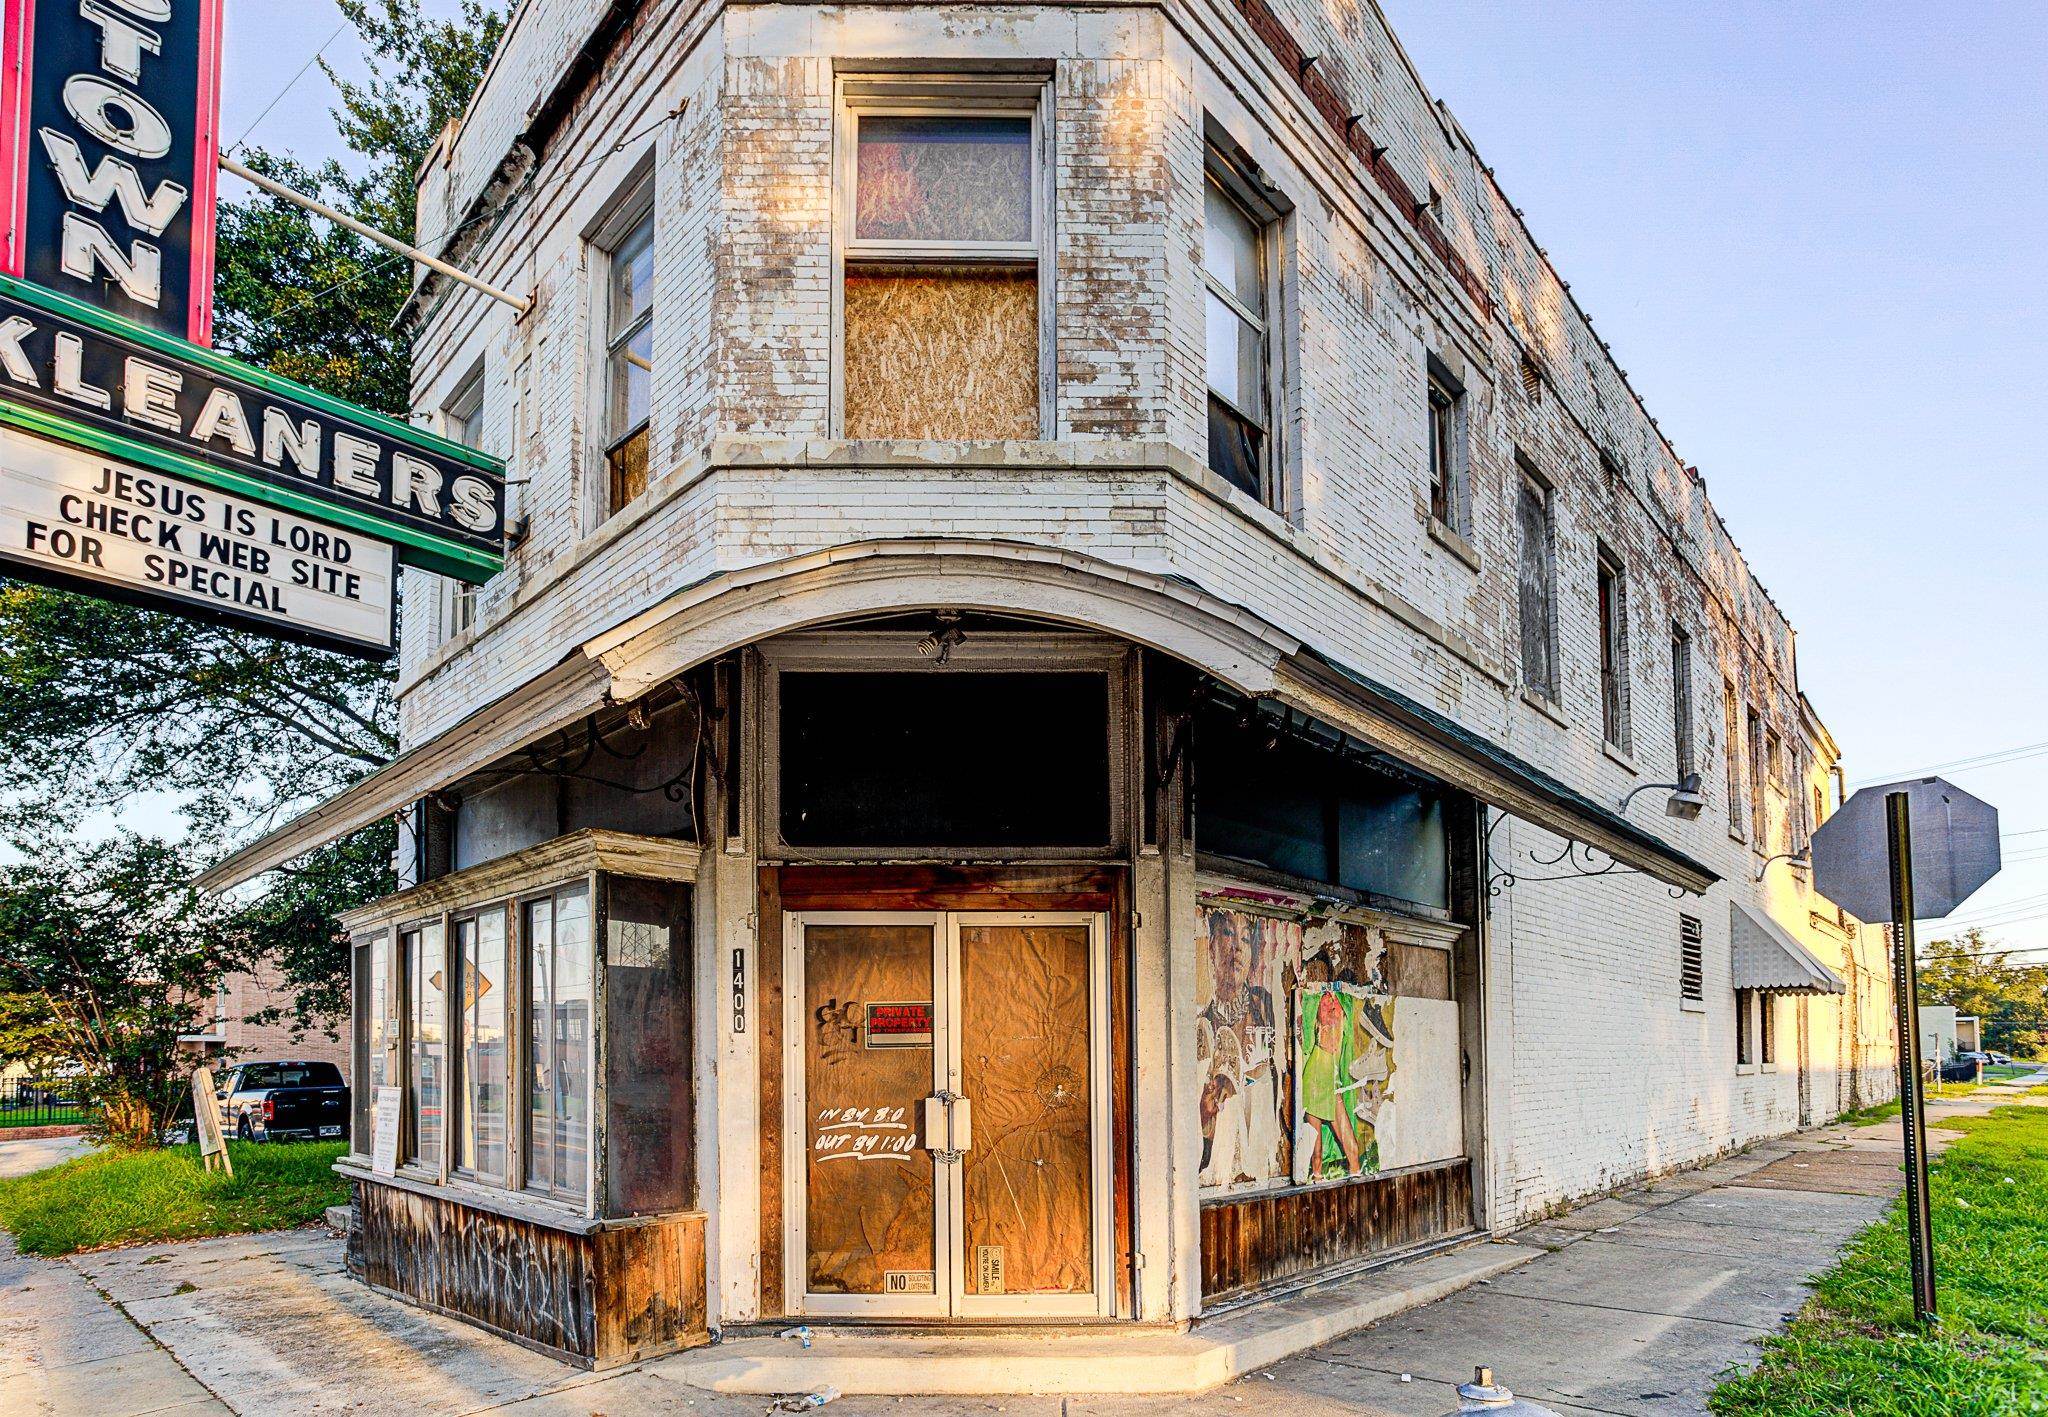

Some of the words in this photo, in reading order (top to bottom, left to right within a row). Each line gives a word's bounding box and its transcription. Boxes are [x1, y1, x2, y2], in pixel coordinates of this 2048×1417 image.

[92, 467, 206, 522] JESUS
[224, 503, 256, 536] IS
[271, 518, 352, 564] LORD
[60, 494, 182, 552] CHECK
[200, 532, 271, 575] WEB
[291, 559, 361, 600] SITE
[26, 520, 104, 568] FOR
[144, 554, 288, 614] SPECIAL
[733, 950, 744, 1031] 1400
[876, 1005, 926, 1017] PRIVATE
[870, 1017, 932, 1028] PROPERTY
[818, 1108, 842, 1121] IN
[841, 1107, 870, 1122] BY
[815, 1134, 852, 1150] OUT
[853, 1135, 879, 1152] BY
[880, 1133, 917, 1152] 1:00
[982, 1265, 989, 1273] ON
[991, 1259, 1000, 1281] SMILE
[890, 1274, 906, 1290] NO
